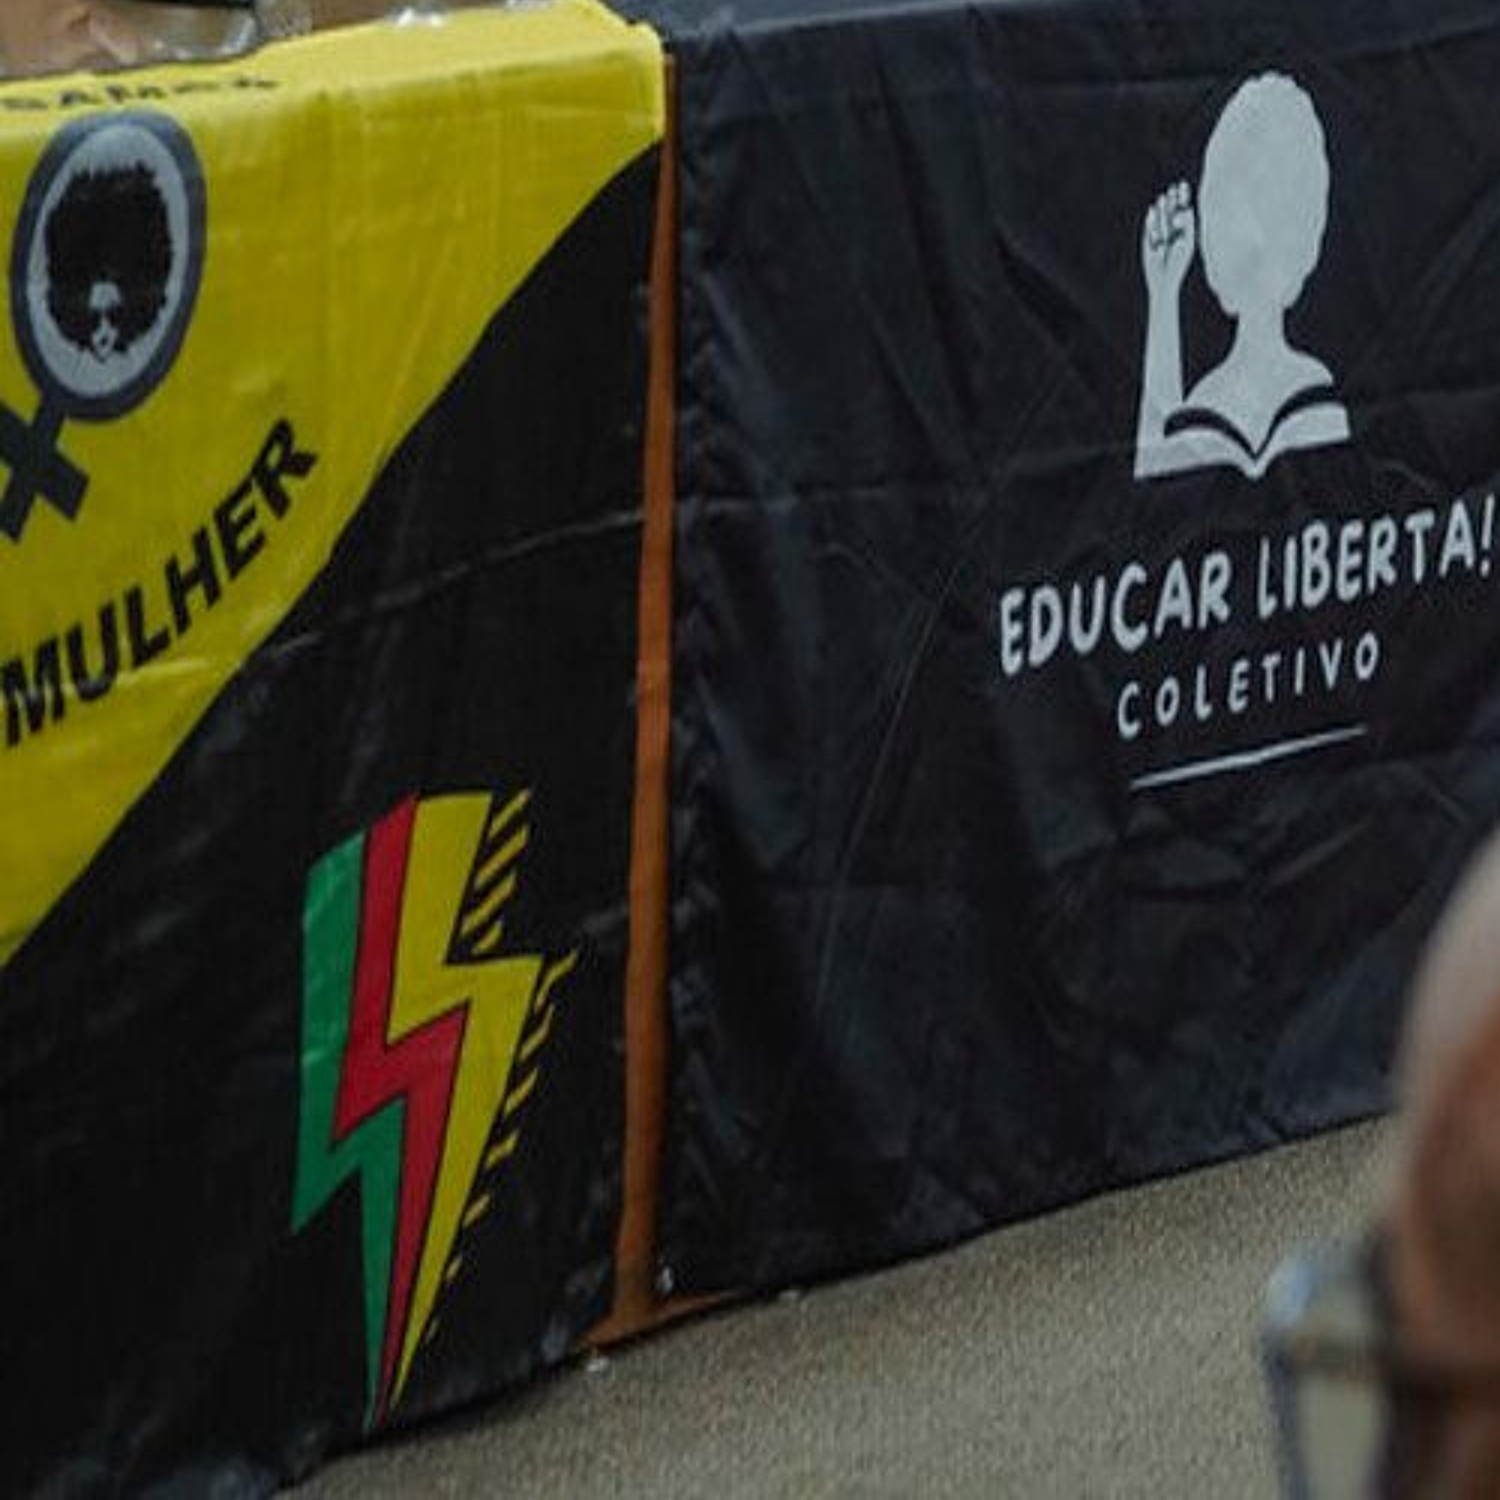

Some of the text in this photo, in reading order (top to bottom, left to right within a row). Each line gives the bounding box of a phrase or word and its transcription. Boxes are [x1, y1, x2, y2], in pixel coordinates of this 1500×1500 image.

[0, 417, 319, 748] MULHER
[1000, 493, 1497, 676] EDUCAR LIBERTA!
[1117, 630, 1380, 739] COLETIVO
